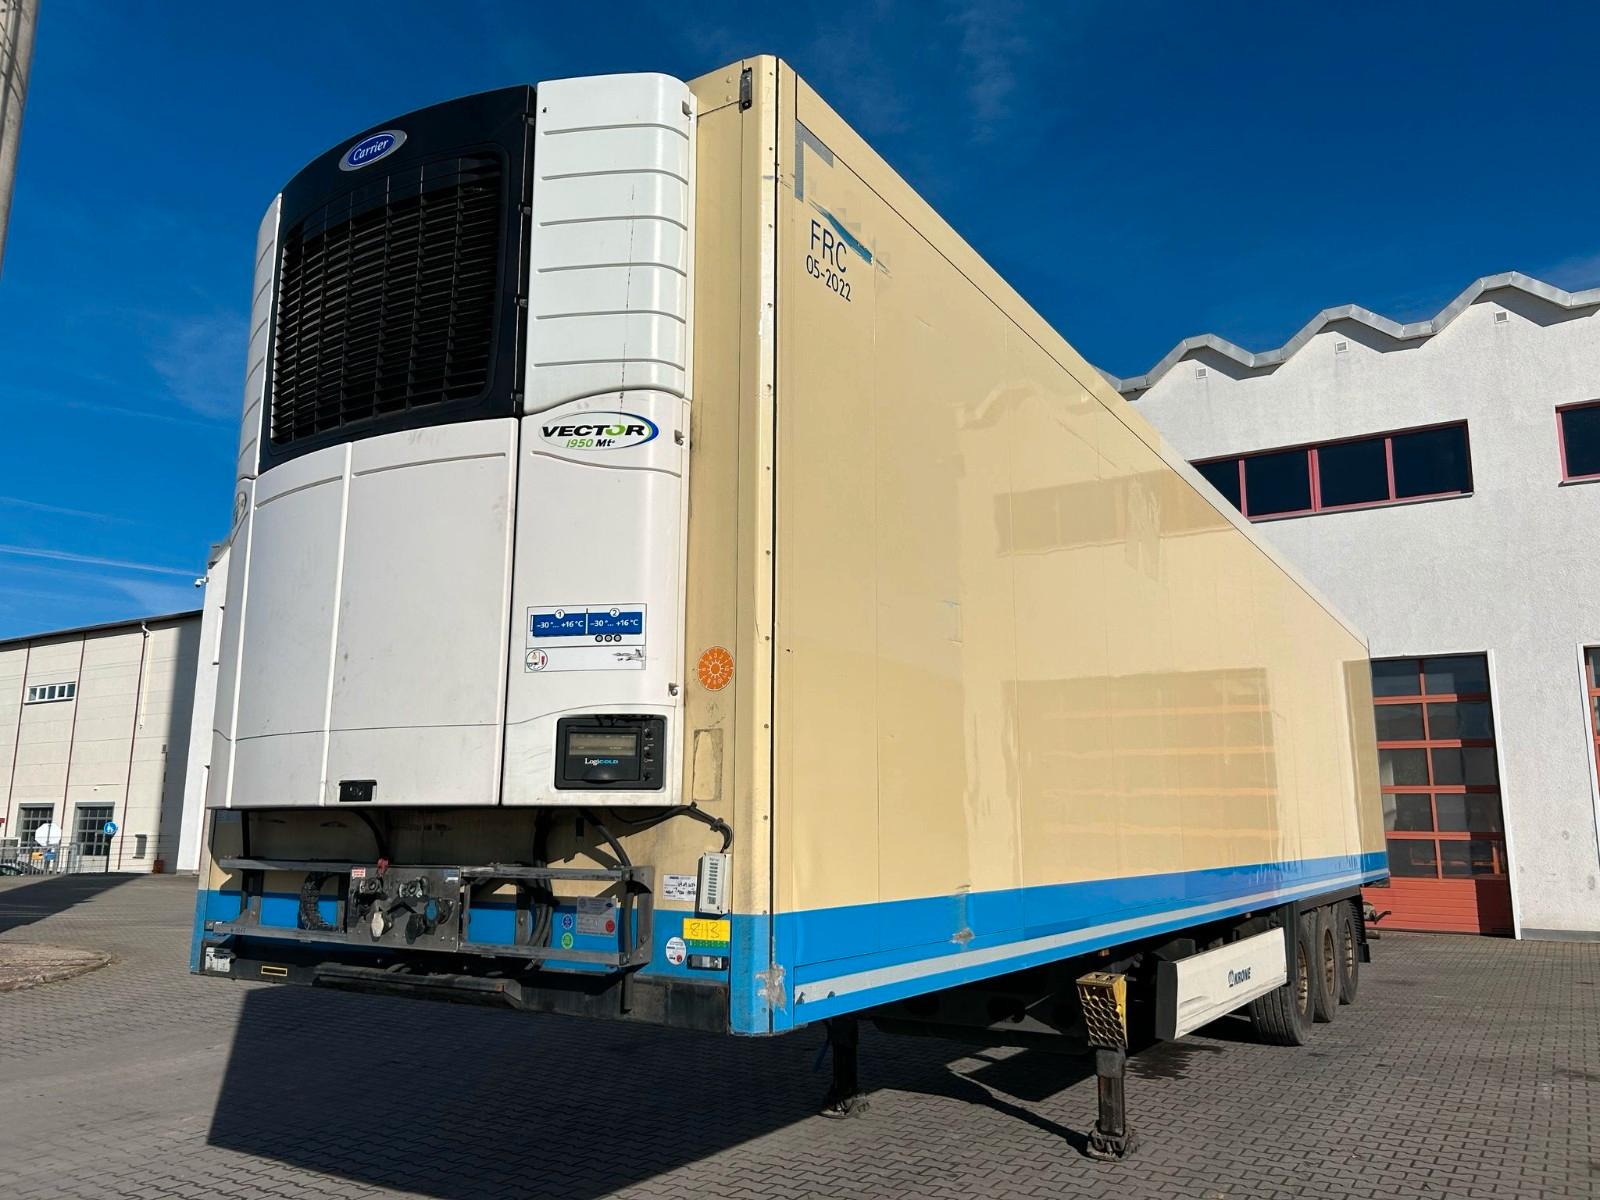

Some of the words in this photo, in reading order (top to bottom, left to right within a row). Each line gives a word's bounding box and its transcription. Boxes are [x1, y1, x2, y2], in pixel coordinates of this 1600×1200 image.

[353, 139, 389, 161] Carrier
[811, 219, 847, 273] FRC
[806, 254, 851, 302] 05-2022
[542, 424, 645, 437] VECTOR
[566, 439, 593, 448] 1950
